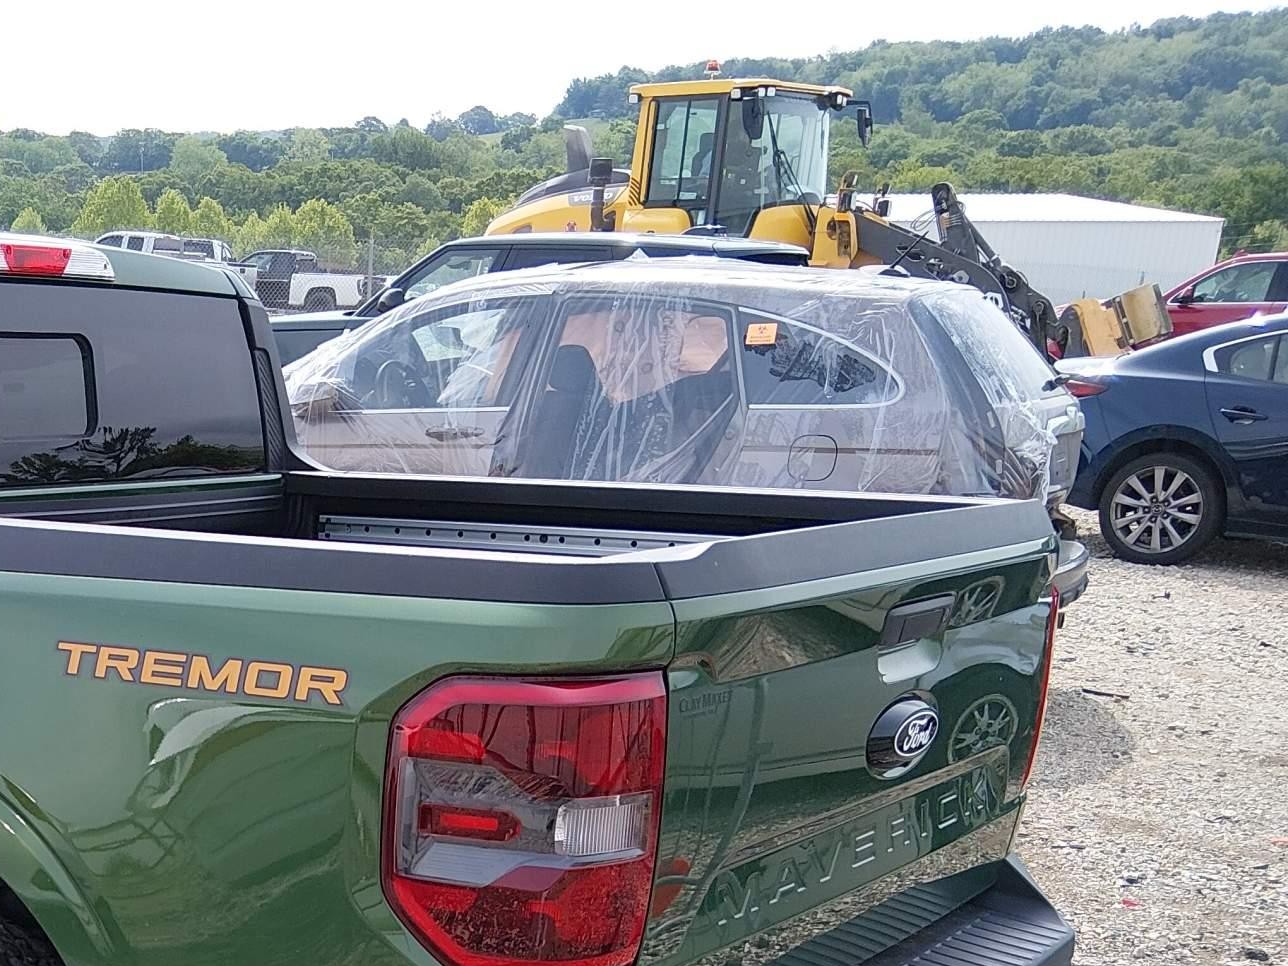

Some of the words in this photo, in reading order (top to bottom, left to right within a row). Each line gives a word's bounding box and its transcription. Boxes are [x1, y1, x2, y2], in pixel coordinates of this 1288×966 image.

[57, 640, 348, 706] TREMOR
[902, 717, 934, 752] Ford
[716, 768, 990, 926] MAVERICK
